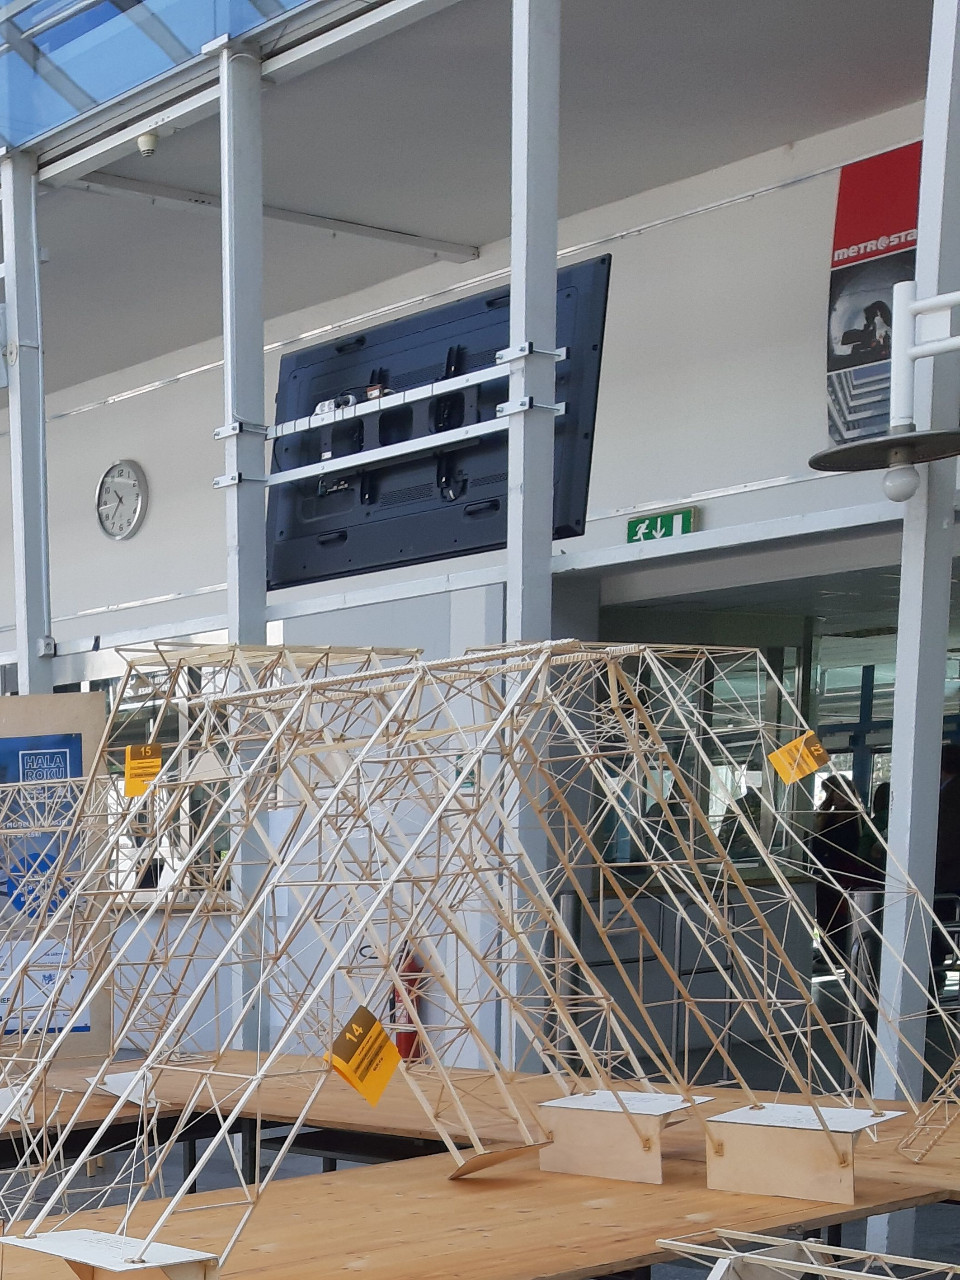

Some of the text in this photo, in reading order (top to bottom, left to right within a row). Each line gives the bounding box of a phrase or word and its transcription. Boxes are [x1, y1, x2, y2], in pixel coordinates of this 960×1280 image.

[140, 746, 152, 756] 15
[810, 744, 824, 757] 22
[24, 754, 65, 769] HALA
[24, 767, 65, 781] ROKU
[345, 1023, 364, 1042] 14
